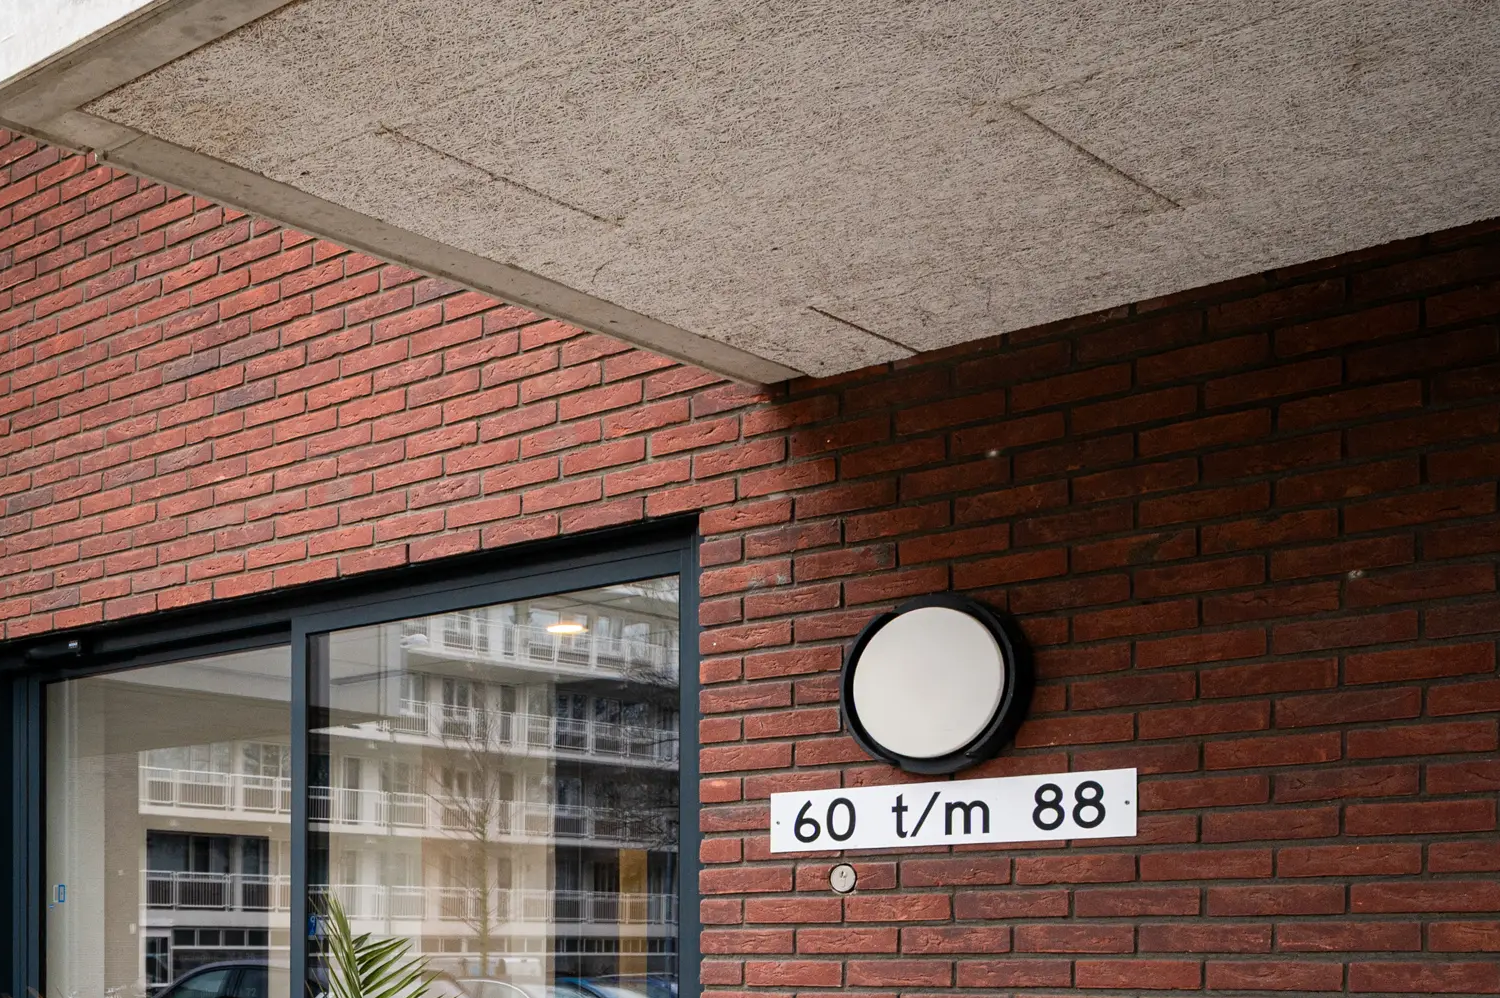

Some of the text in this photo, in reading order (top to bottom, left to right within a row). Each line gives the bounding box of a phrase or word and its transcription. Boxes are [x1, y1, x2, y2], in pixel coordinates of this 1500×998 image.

[794, 781, 1105, 843] 60 t/m 88
